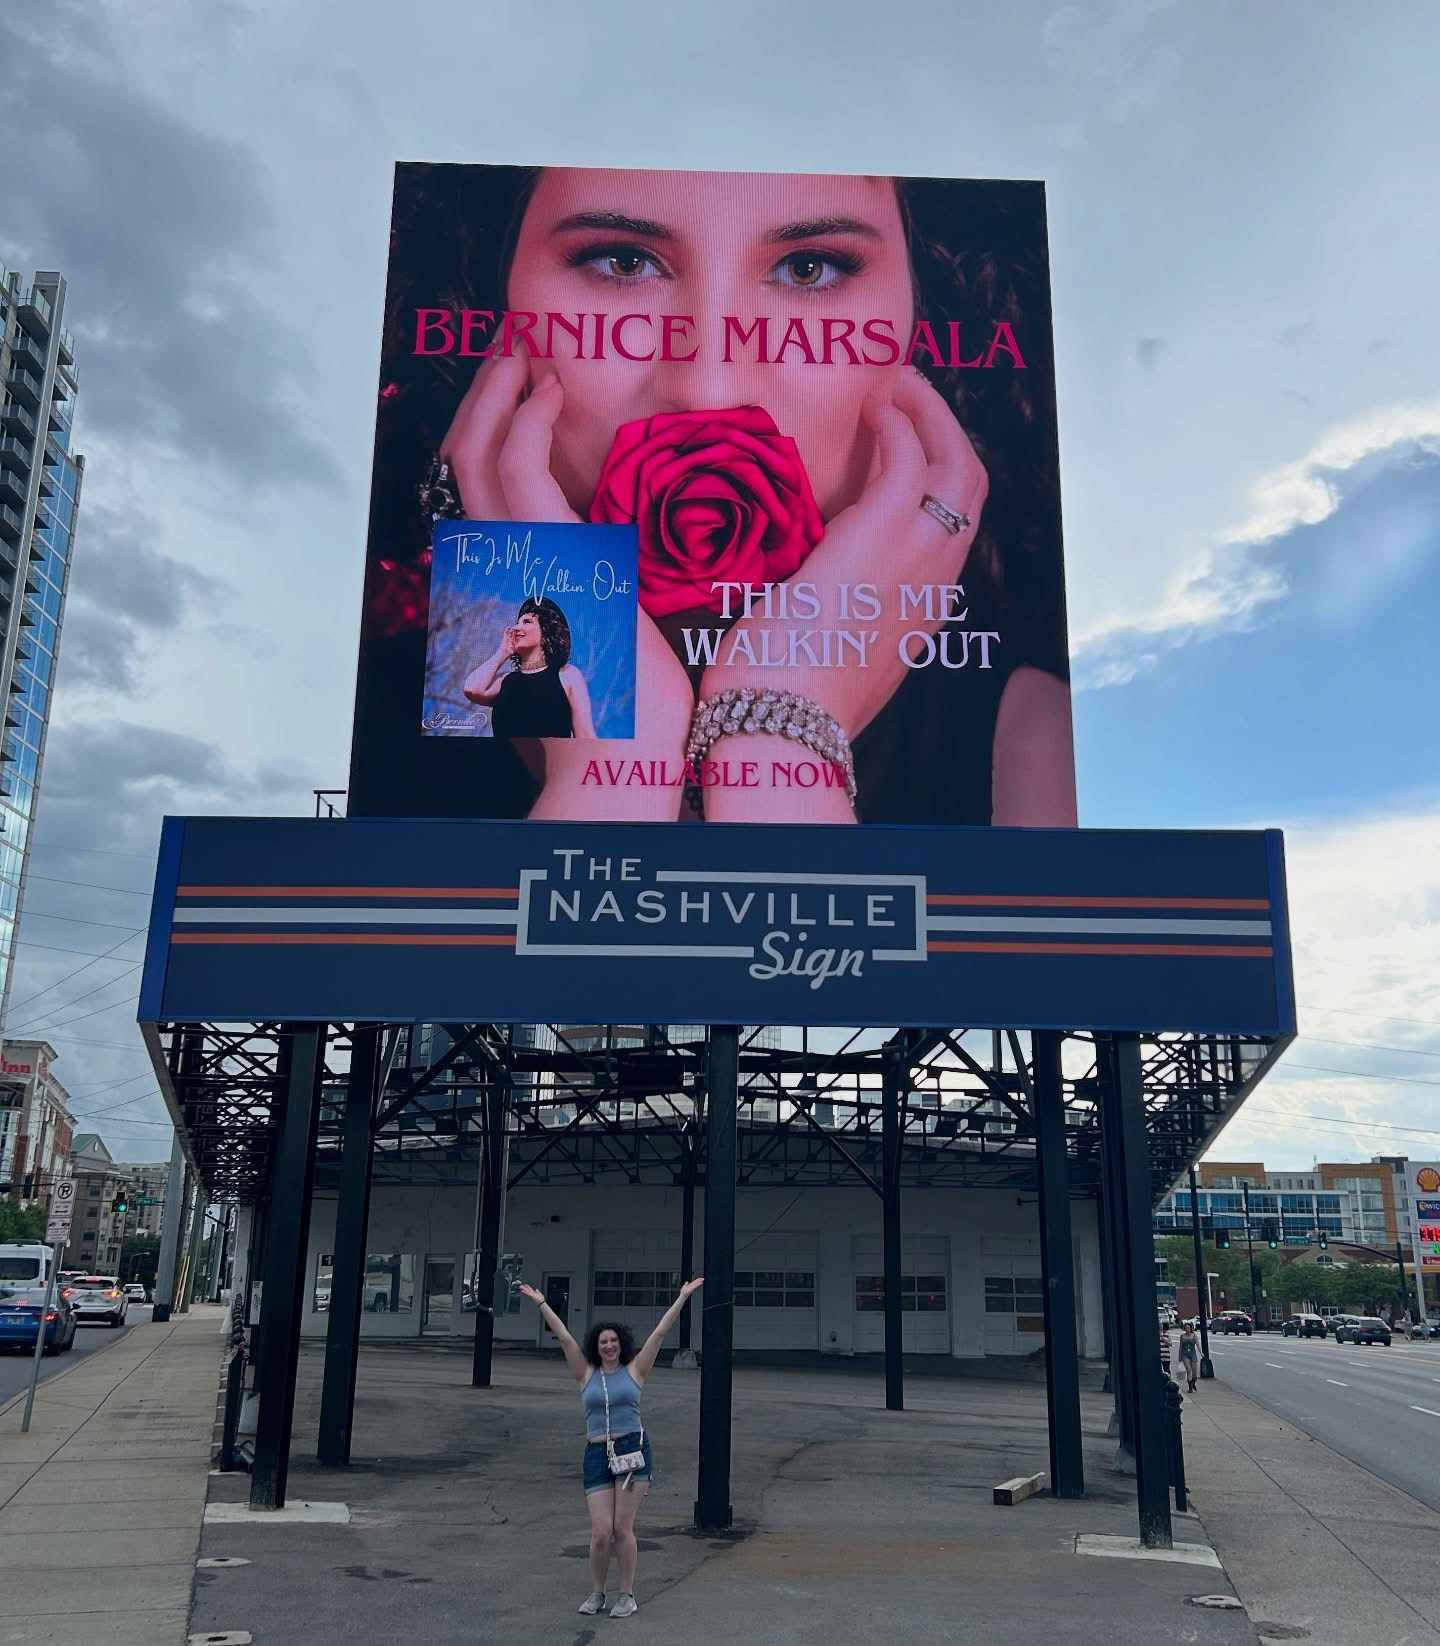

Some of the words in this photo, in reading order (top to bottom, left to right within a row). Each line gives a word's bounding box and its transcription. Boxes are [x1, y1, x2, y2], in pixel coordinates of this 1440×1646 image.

[411, 308, 700, 362] BERNICE
[720, 316, 1027, 368] MARSALA
[442, 533, 483, 573] This
[506, 530, 544, 577] Me
[593, 560, 632, 601] Out
[711, 582, 821, 620] THIS
[838, 583, 882, 621] IS
[898, 584, 968, 621] ME
[898, 630, 1001, 669] OUT
[580, 760, 760, 788] AVAILABLE
[771, 762, 849, 788] NOW
[548, 890, 895, 927] NASHVILLE
[749, 931, 863, 990] Sign
